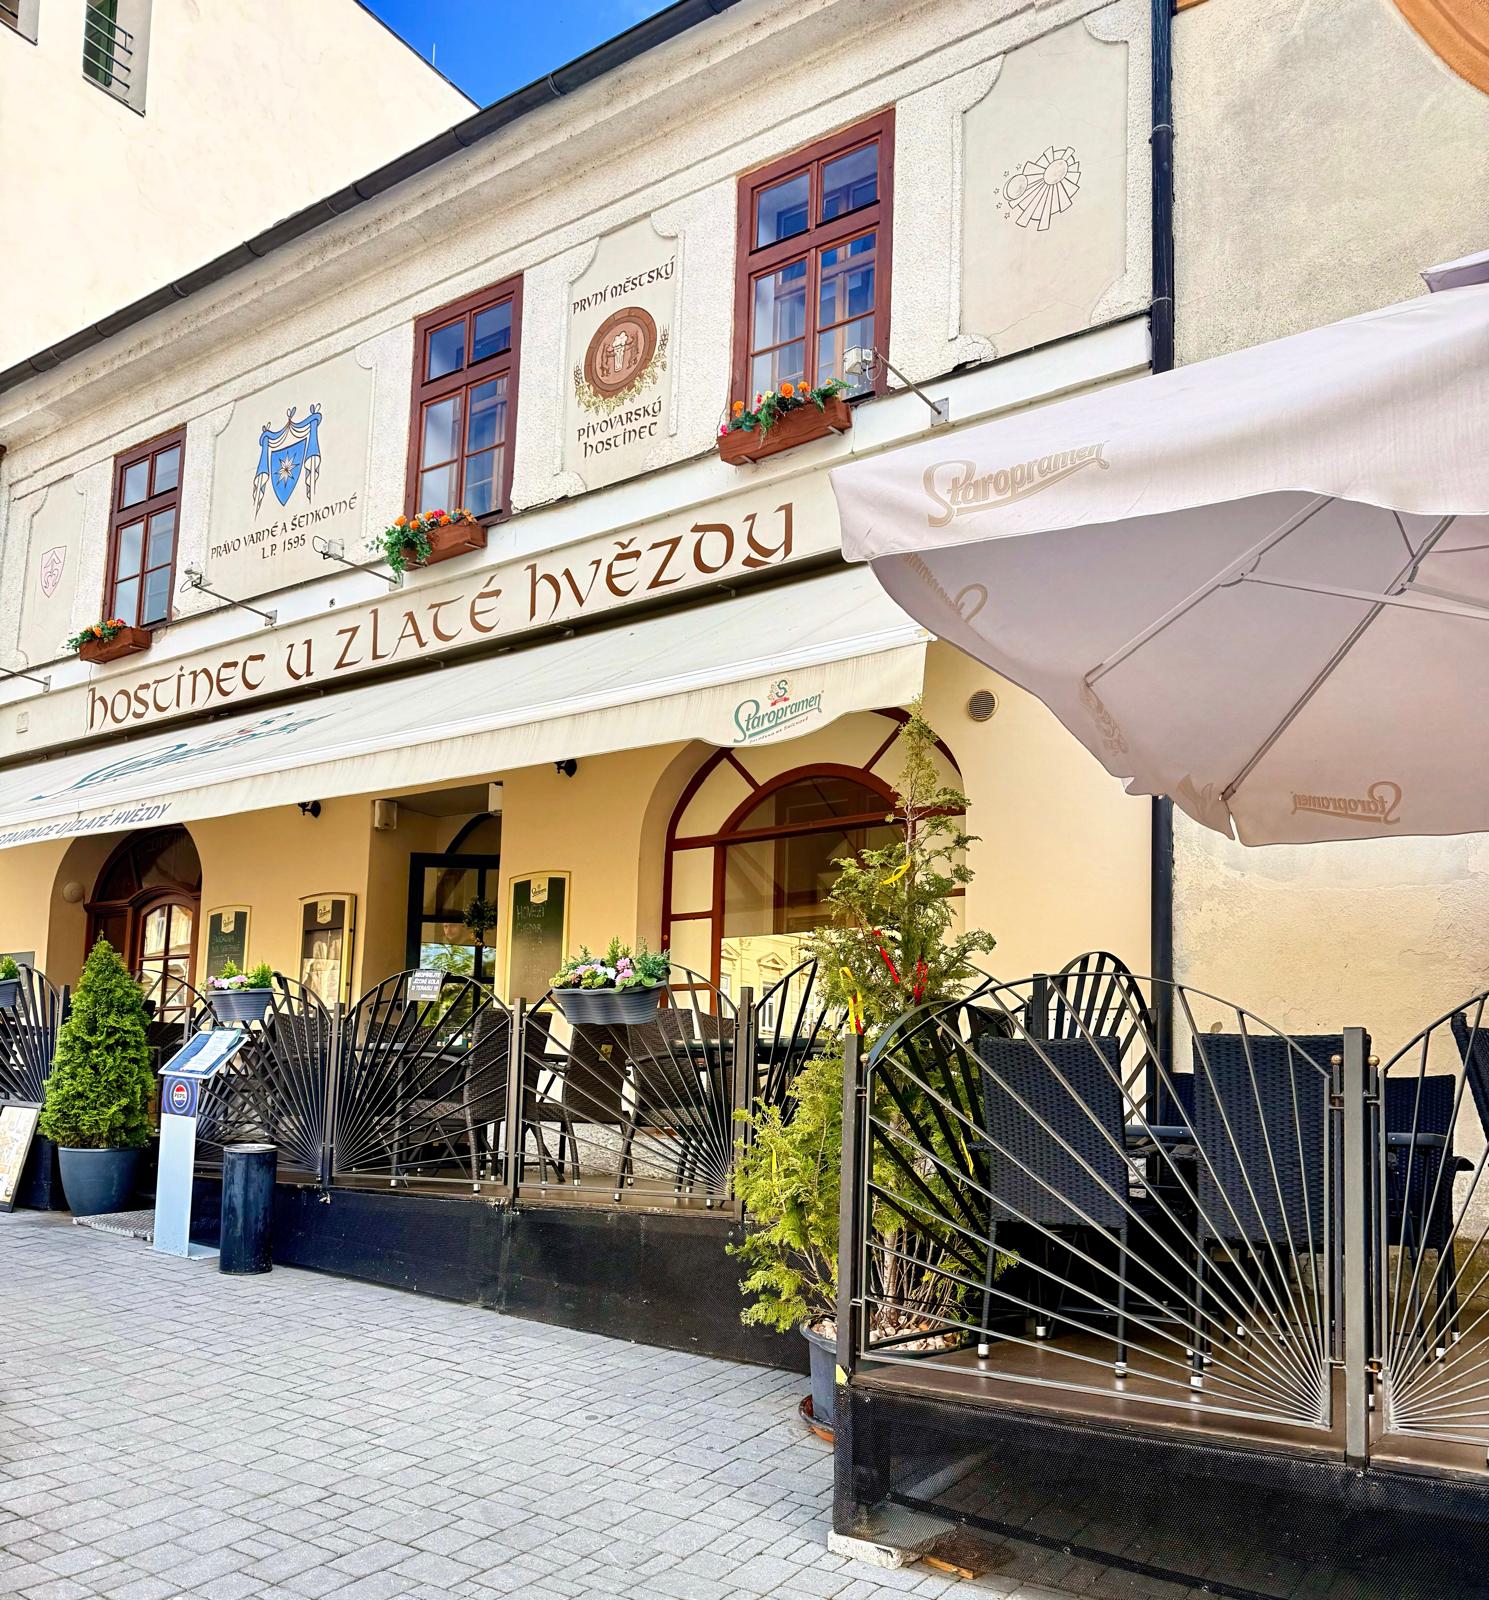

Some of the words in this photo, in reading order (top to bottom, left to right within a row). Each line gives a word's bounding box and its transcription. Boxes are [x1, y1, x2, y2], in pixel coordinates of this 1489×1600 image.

[572, 284, 610, 316] PRVNÍ
[610, 254, 676, 298] MĚSTSKÝ
[577, 395, 663, 442] PIVOVARSKÝ
[922, 439, 1112, 528] Staropramen
[210, 538, 241, 560] PRÁVO
[244, 520, 279, 547] VARNÉ
[280, 521, 288, 536] A
[290, 491, 358, 532] ŠENKOVNÉ
[282, 533, 307, 553] 1595
[286, 638, 315, 681] U
[333, 574, 502, 671] ZLATÉ
[524, 502, 794, 622] HVĚZDY
[733, 693, 823, 744] Staropramen
[67, 808, 116, 834] ZLATÉ
[109, 802, 173, 827] HVĚZDY
